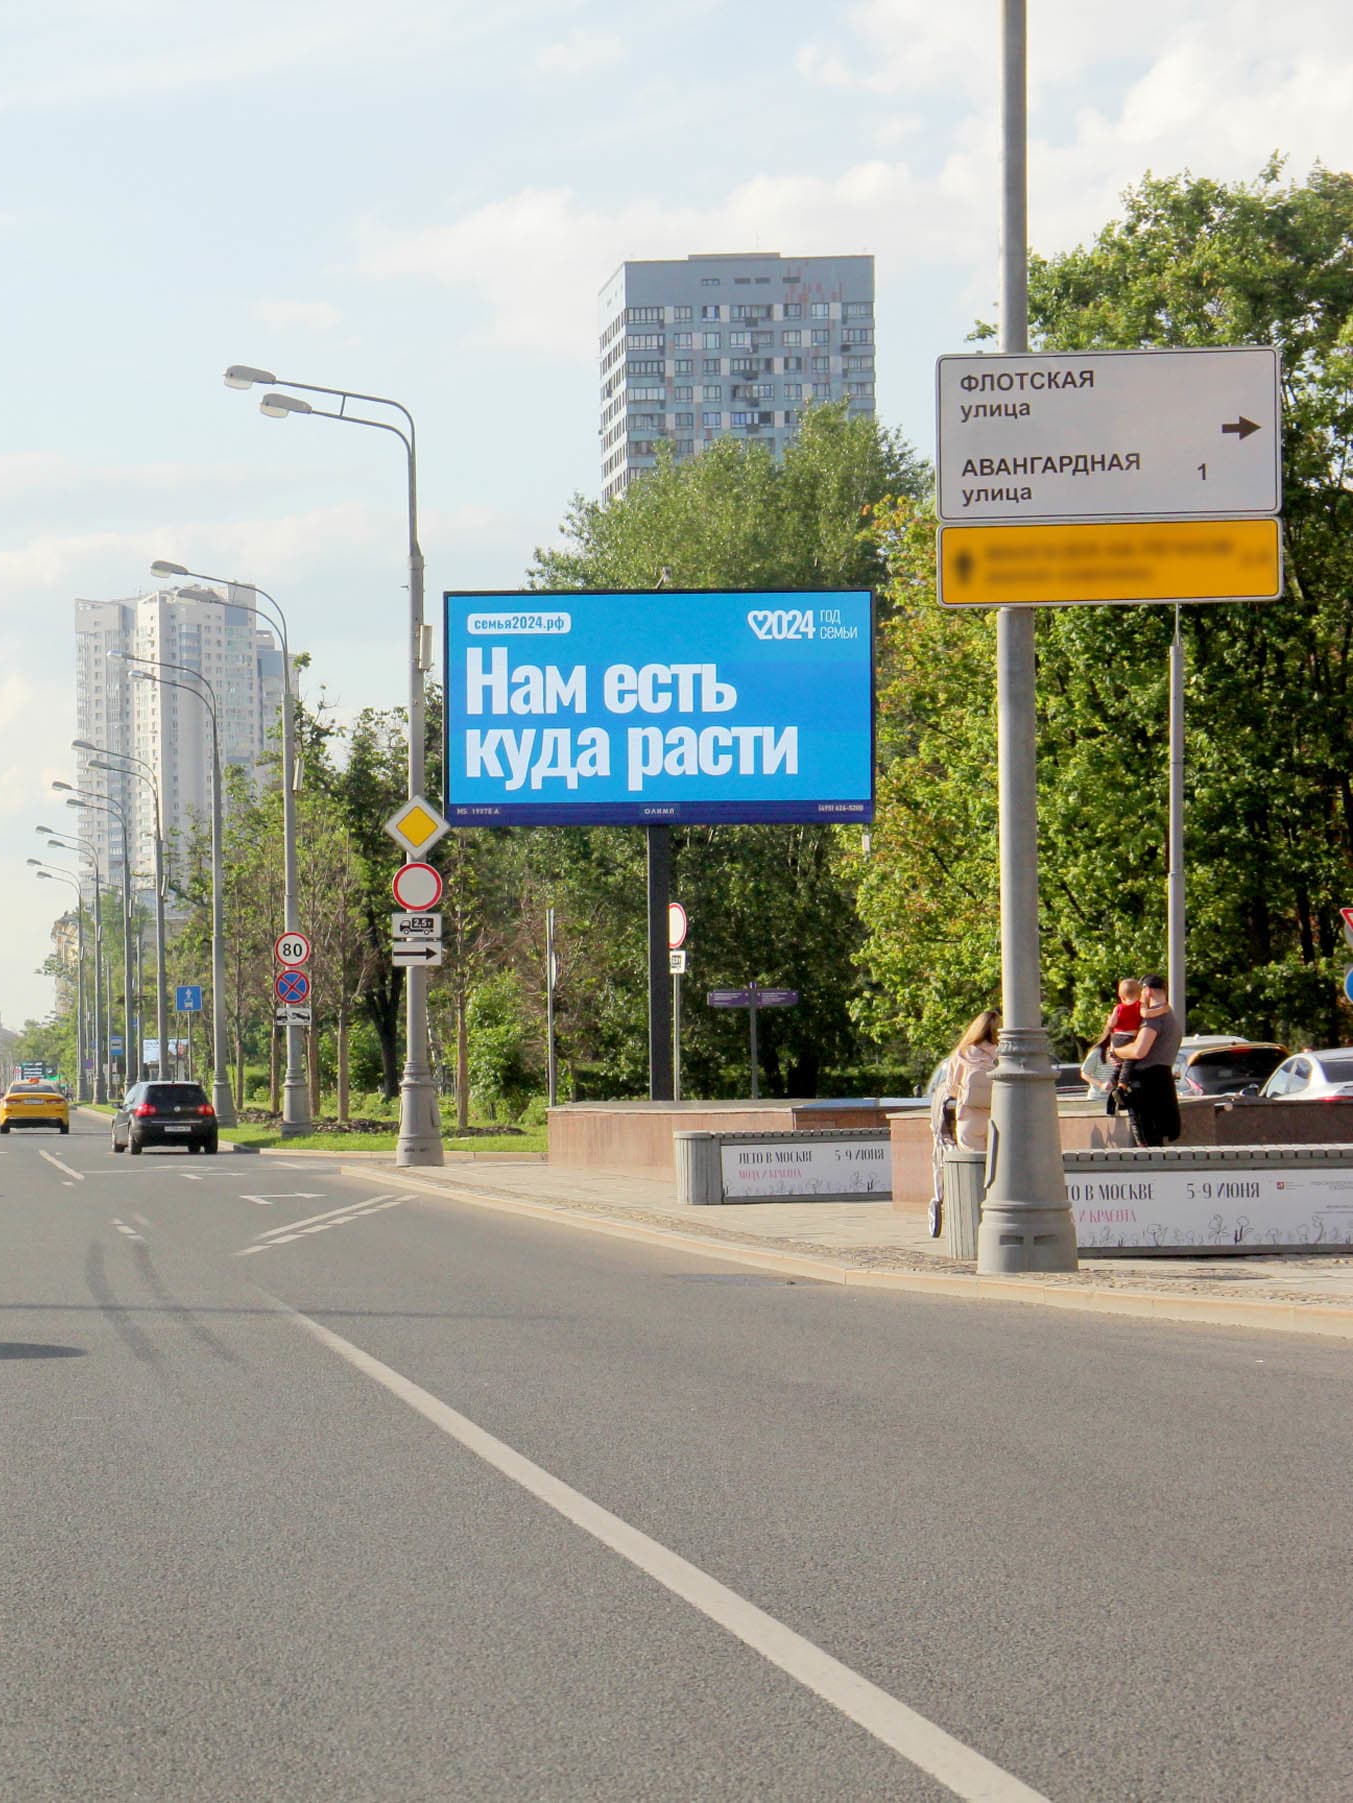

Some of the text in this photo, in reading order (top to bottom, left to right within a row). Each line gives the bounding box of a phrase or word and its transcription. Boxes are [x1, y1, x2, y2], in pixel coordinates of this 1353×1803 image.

[960, 369, 1095, 392] ФЛОТСКАЯ
[960, 400, 1031, 423] улица
[962, 452, 1207, 481] АВАНГАРДНАЯ 1
[962, 486, 1033, 507] улица
[474, 615, 565, 632] семья2024.рф
[748, 609, 816, 640] 2024
[820, 609, 842, 625] год
[820, 626, 859, 640] семьи
[466, 646, 738, 715] Нам есть
[465, 725, 799, 792] куда расти
[282, 943, 303, 958] 80
[738, 1151, 764, 1164] ЛЕТО
[766, 1151, 773, 1163] В
[775, 1150, 813, 1163] МОСКВЕ
[855, 1148, 885, 1161] ИЮНЯ
[1085, 1184, 1095, 1200] В
[1098, 1183, 1154, 1200] МОСКВЕ
[1216, 1182, 1260, 1199] ИЮНЯ
[1089, 1208, 1137, 1224] КРАСОТА
